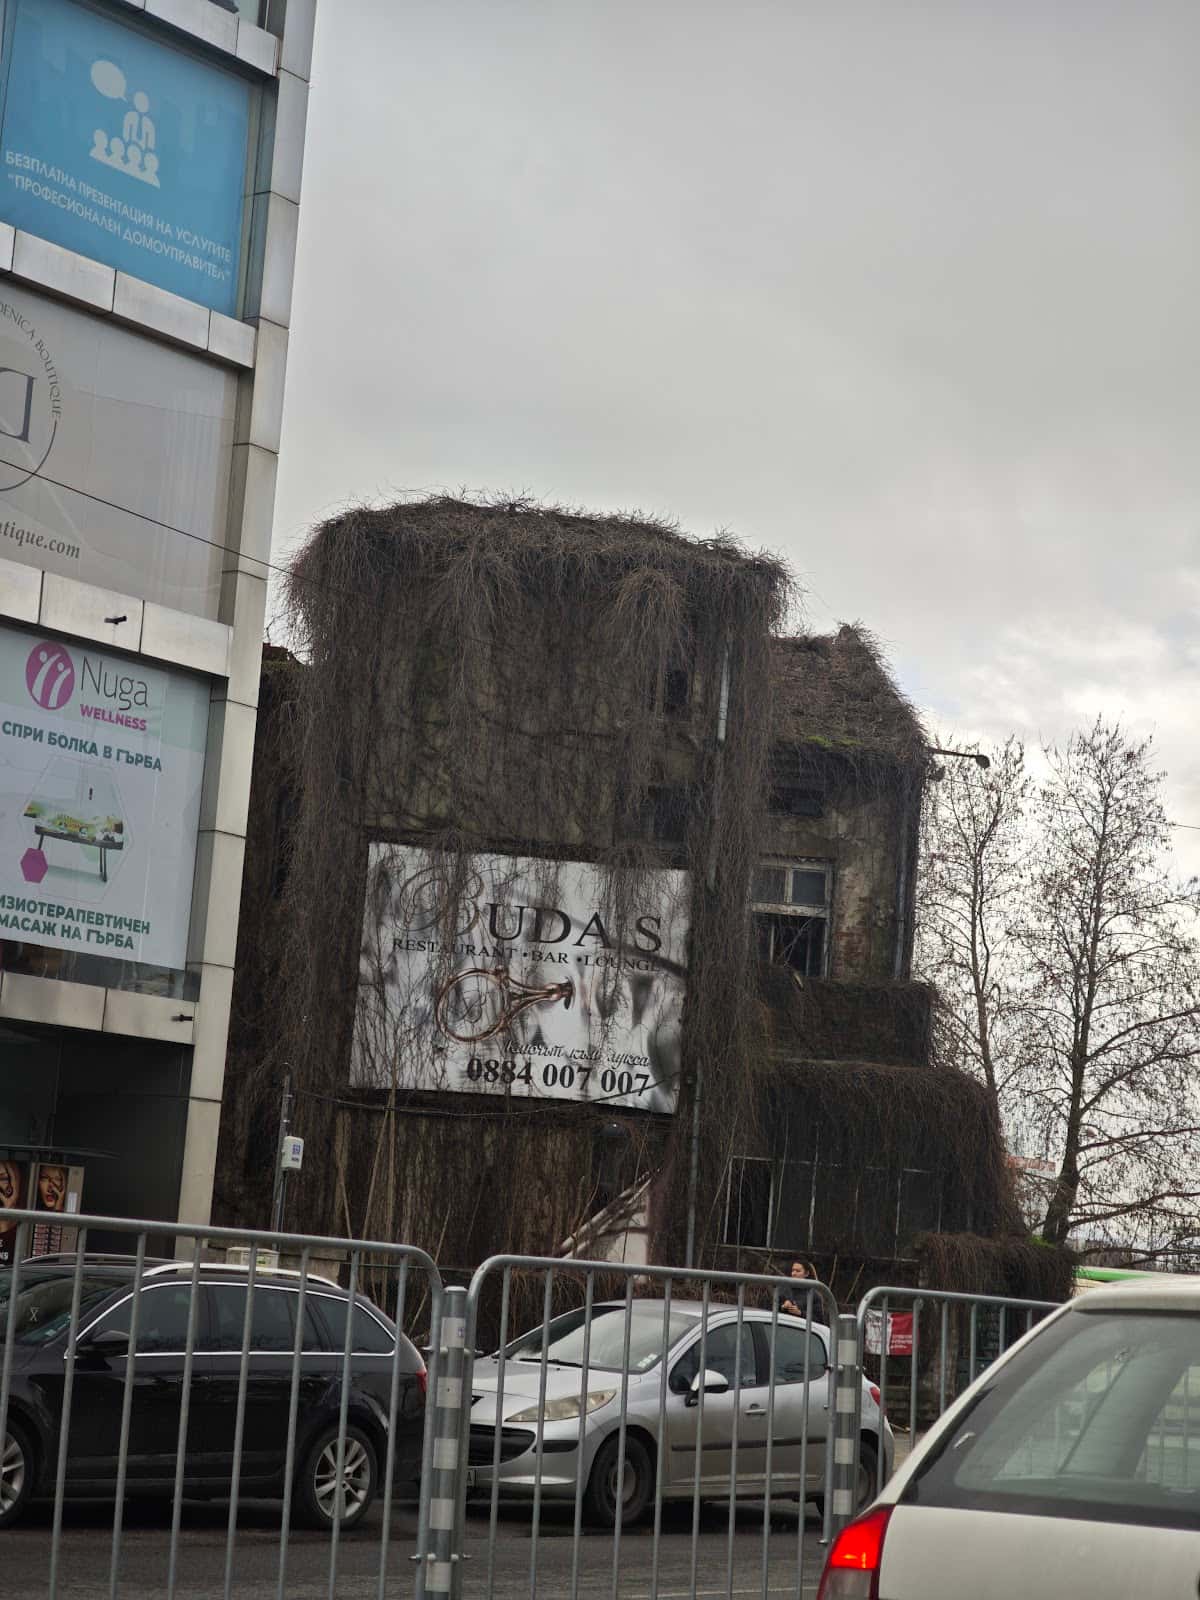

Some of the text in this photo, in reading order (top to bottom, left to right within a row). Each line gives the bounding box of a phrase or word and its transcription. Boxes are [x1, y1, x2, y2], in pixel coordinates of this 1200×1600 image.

[6, 151, 232, 264] БЕЗПЛАТНА ПРЕЗЕНТАЦИЯ НА УСЛУГИТЕ
[35, 339, 61, 418] BOUTIQUE
[81, 656, 148, 711] Nuga
[80, 703, 147, 731] WELLNESS
[2, 721, 162, 772] СПРИ БОЛКА В ГЪРБА
[0, 913, 134, 950] МАСАЖ НА ГЪРБА
[531, 950, 568, 965] BAR
[467, 1058, 650, 1097] 0884 007 007
